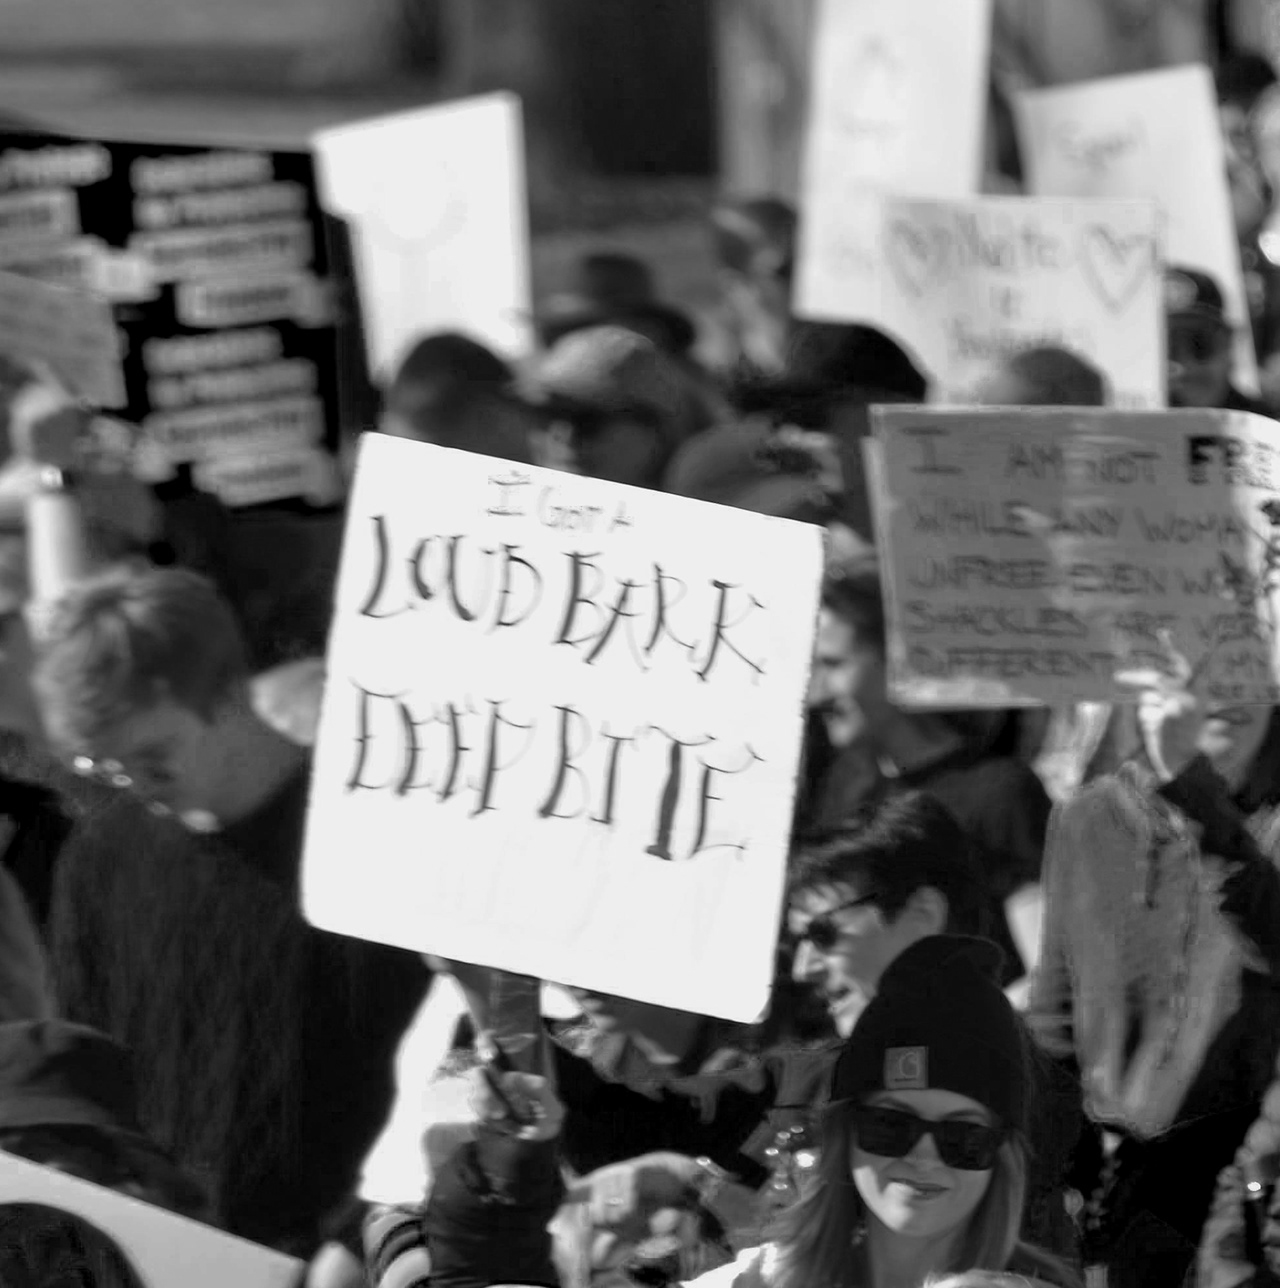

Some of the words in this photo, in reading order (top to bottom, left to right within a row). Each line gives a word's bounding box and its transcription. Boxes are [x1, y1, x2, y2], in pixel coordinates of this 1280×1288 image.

[359, 513, 544, 635] LOUD
[551, 548, 768, 684] BARK
[343, 676, 538, 819] DEEP
[536, 703, 767, 863] BITE
